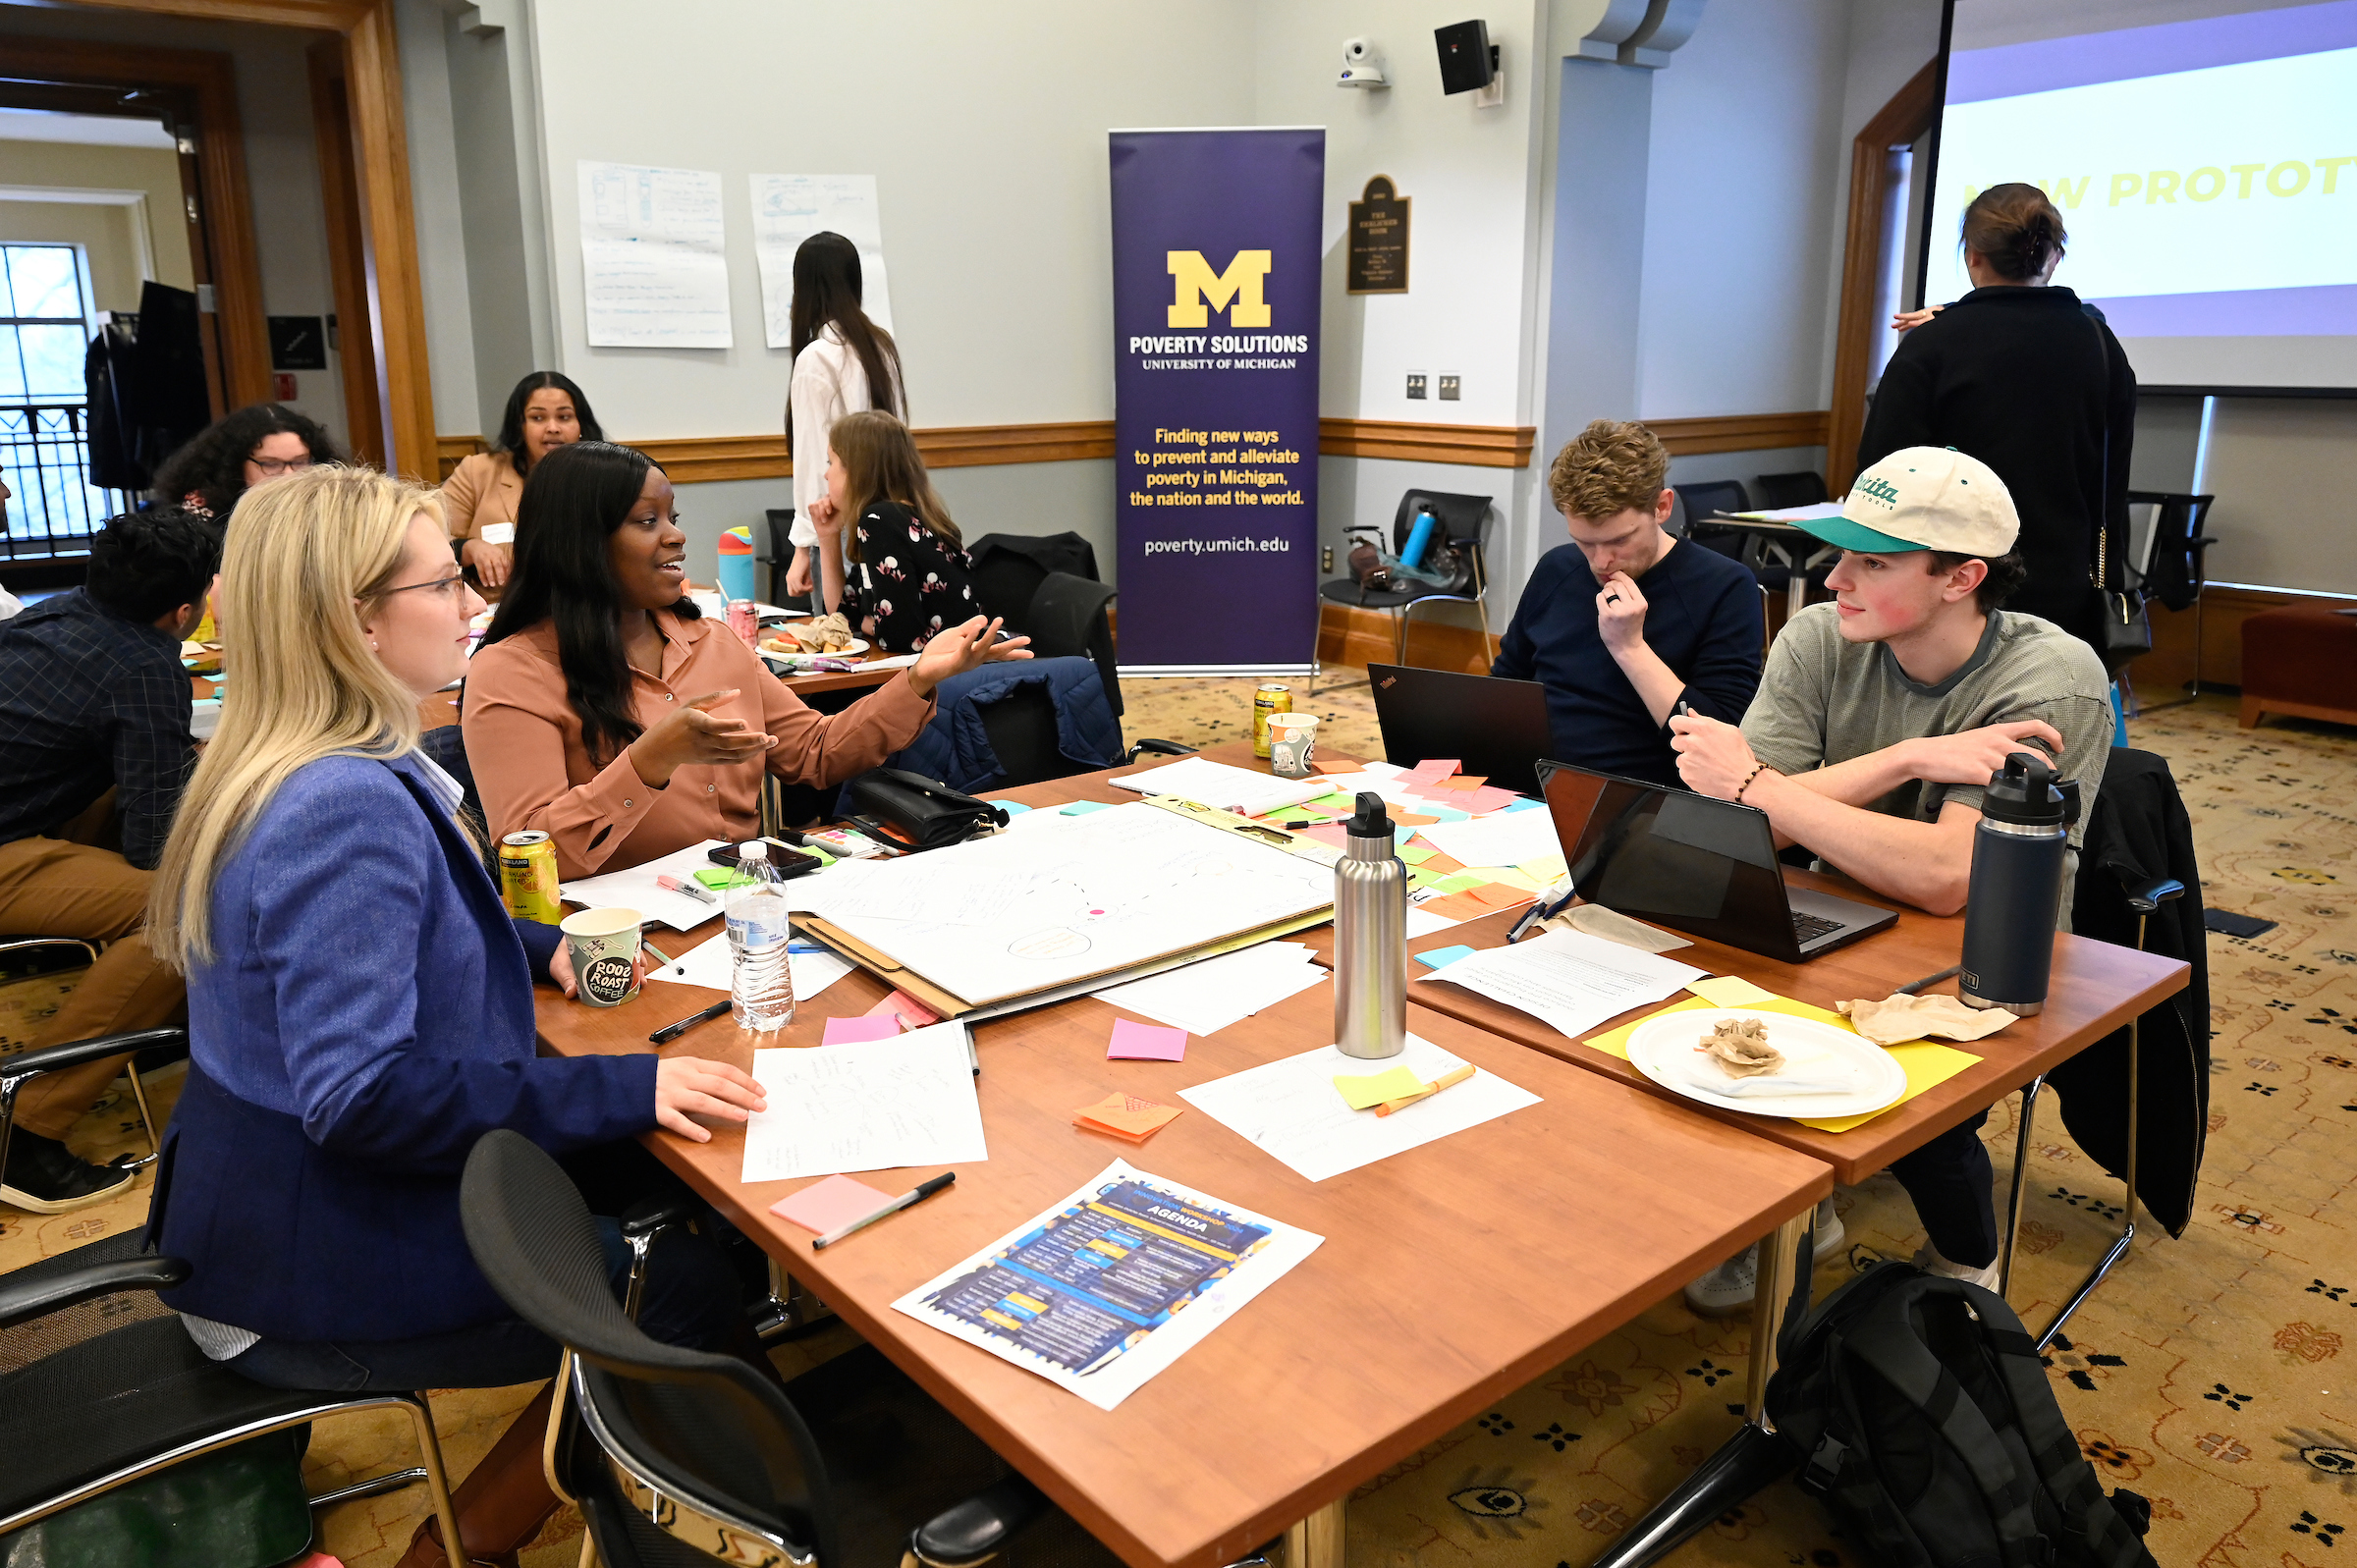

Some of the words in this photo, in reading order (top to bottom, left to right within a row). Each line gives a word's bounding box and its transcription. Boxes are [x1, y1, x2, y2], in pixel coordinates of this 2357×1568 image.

[2109, 155, 2357, 207] PROTOT
[1167, 249, 1272, 328] M
[1129, 335, 1207, 354] POVERTY
[1210, 335, 1308, 353] SOLUTIONS
[1142, 358, 1214, 370] UNIVERSITY
[1216, 358, 1233, 370] OF
[1233, 357, 1296, 370] MICHIGAN
[1155, 428, 1208, 446] Finding
[1211, 431, 1240, 443] new
[1243, 431, 1280, 447] ways
[1134, 450, 1150, 464] to
[1153, 451, 1207, 468] prevent
[1210, 449, 1237, 464] and
[1239, 449, 1300, 464] alleviate
[1146, 470, 1200, 489] poverty
[1203, 469, 1217, 484] in
[1220, 468, 1288, 488] Michigan,
[1130, 491, 1154, 507] the
[1157, 492, 1202, 507] nation
[1205, 491, 1232, 506] and
[1234, 491, 1258, 506] the
[1261, 490, 1304, 506] world.
[1144, 536, 1289, 557] poverty.umich.edu
[590, 972, 630, 990] ROAST
[1959, 969, 1976, 986] ETI
[589, 983, 624, 999] COFFEE
[1133, 1189, 1181, 1211] INNOVATION
[1180, 1207, 1226, 1226] WORKSHOP
[1147, 1205, 1209, 1232] AGENDA
